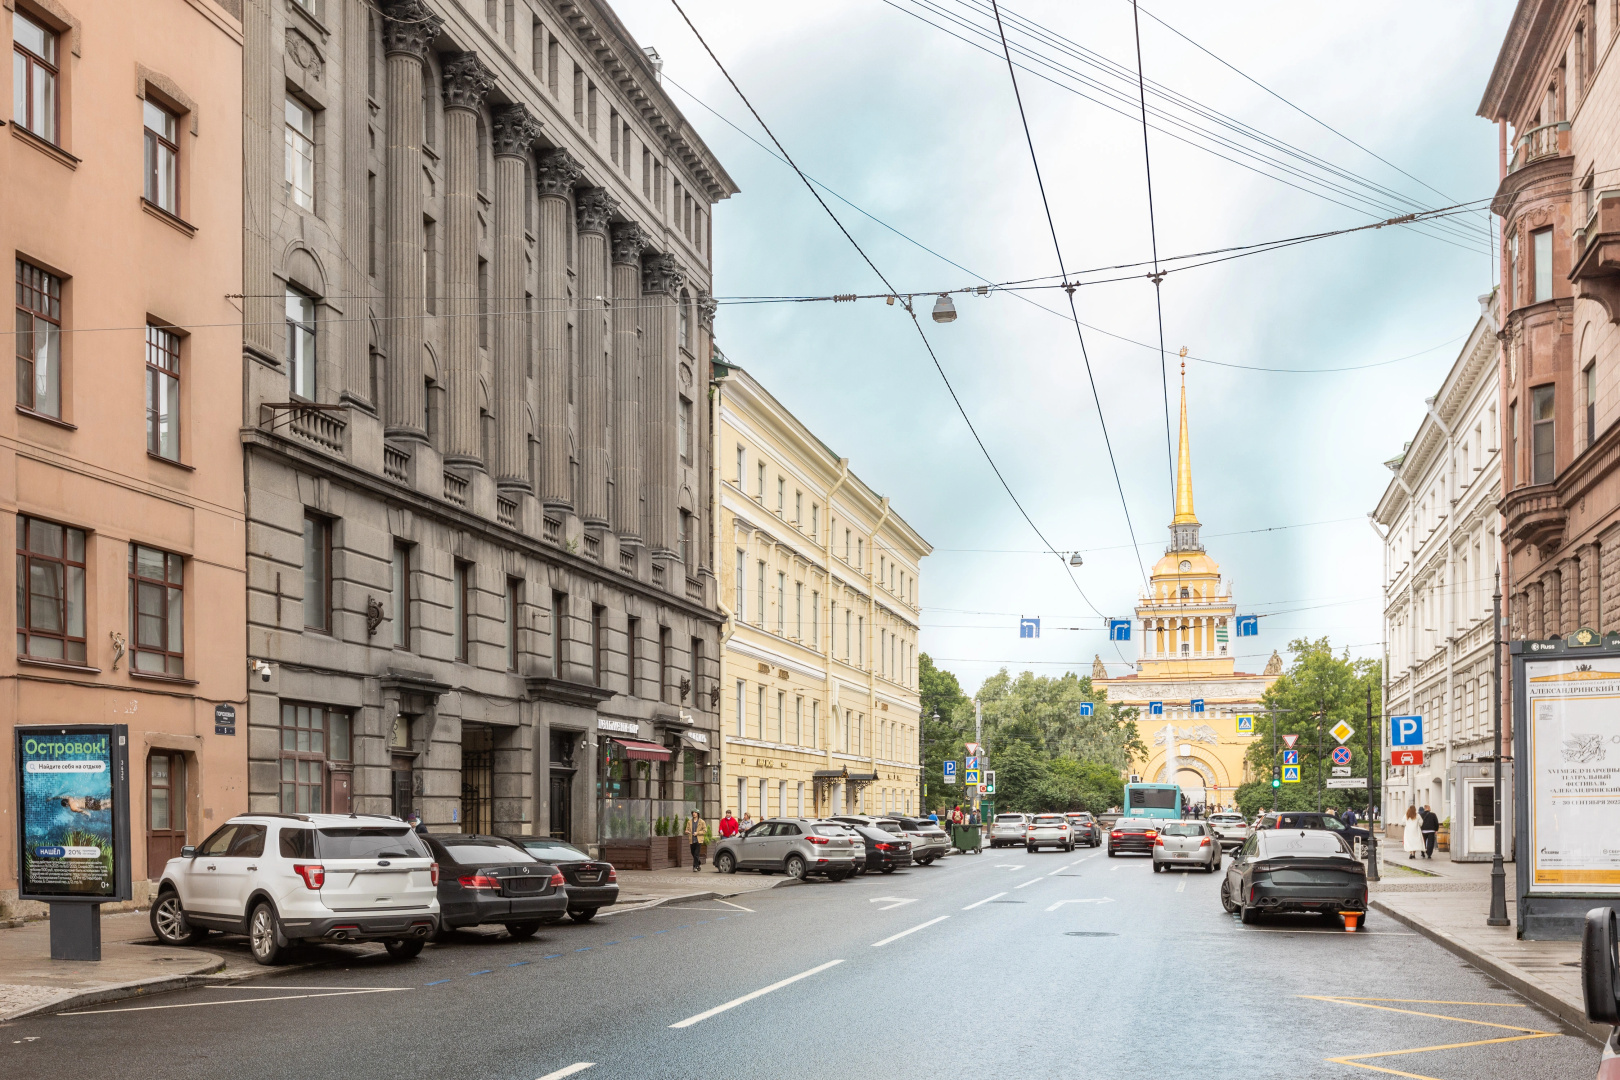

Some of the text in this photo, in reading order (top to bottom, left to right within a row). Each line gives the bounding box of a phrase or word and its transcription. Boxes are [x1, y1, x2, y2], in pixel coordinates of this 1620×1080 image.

[1529, 685, 1614, 695] АЛЕКСАНДРИНСКИЙ
[1399, 718, 1418, 744] P
[25, 737, 106, 758] Островок!
[946, 762, 954, 775] P
[40, 847, 61, 856] НАШЁЛ
[100, 881, 110, 889] 0+
